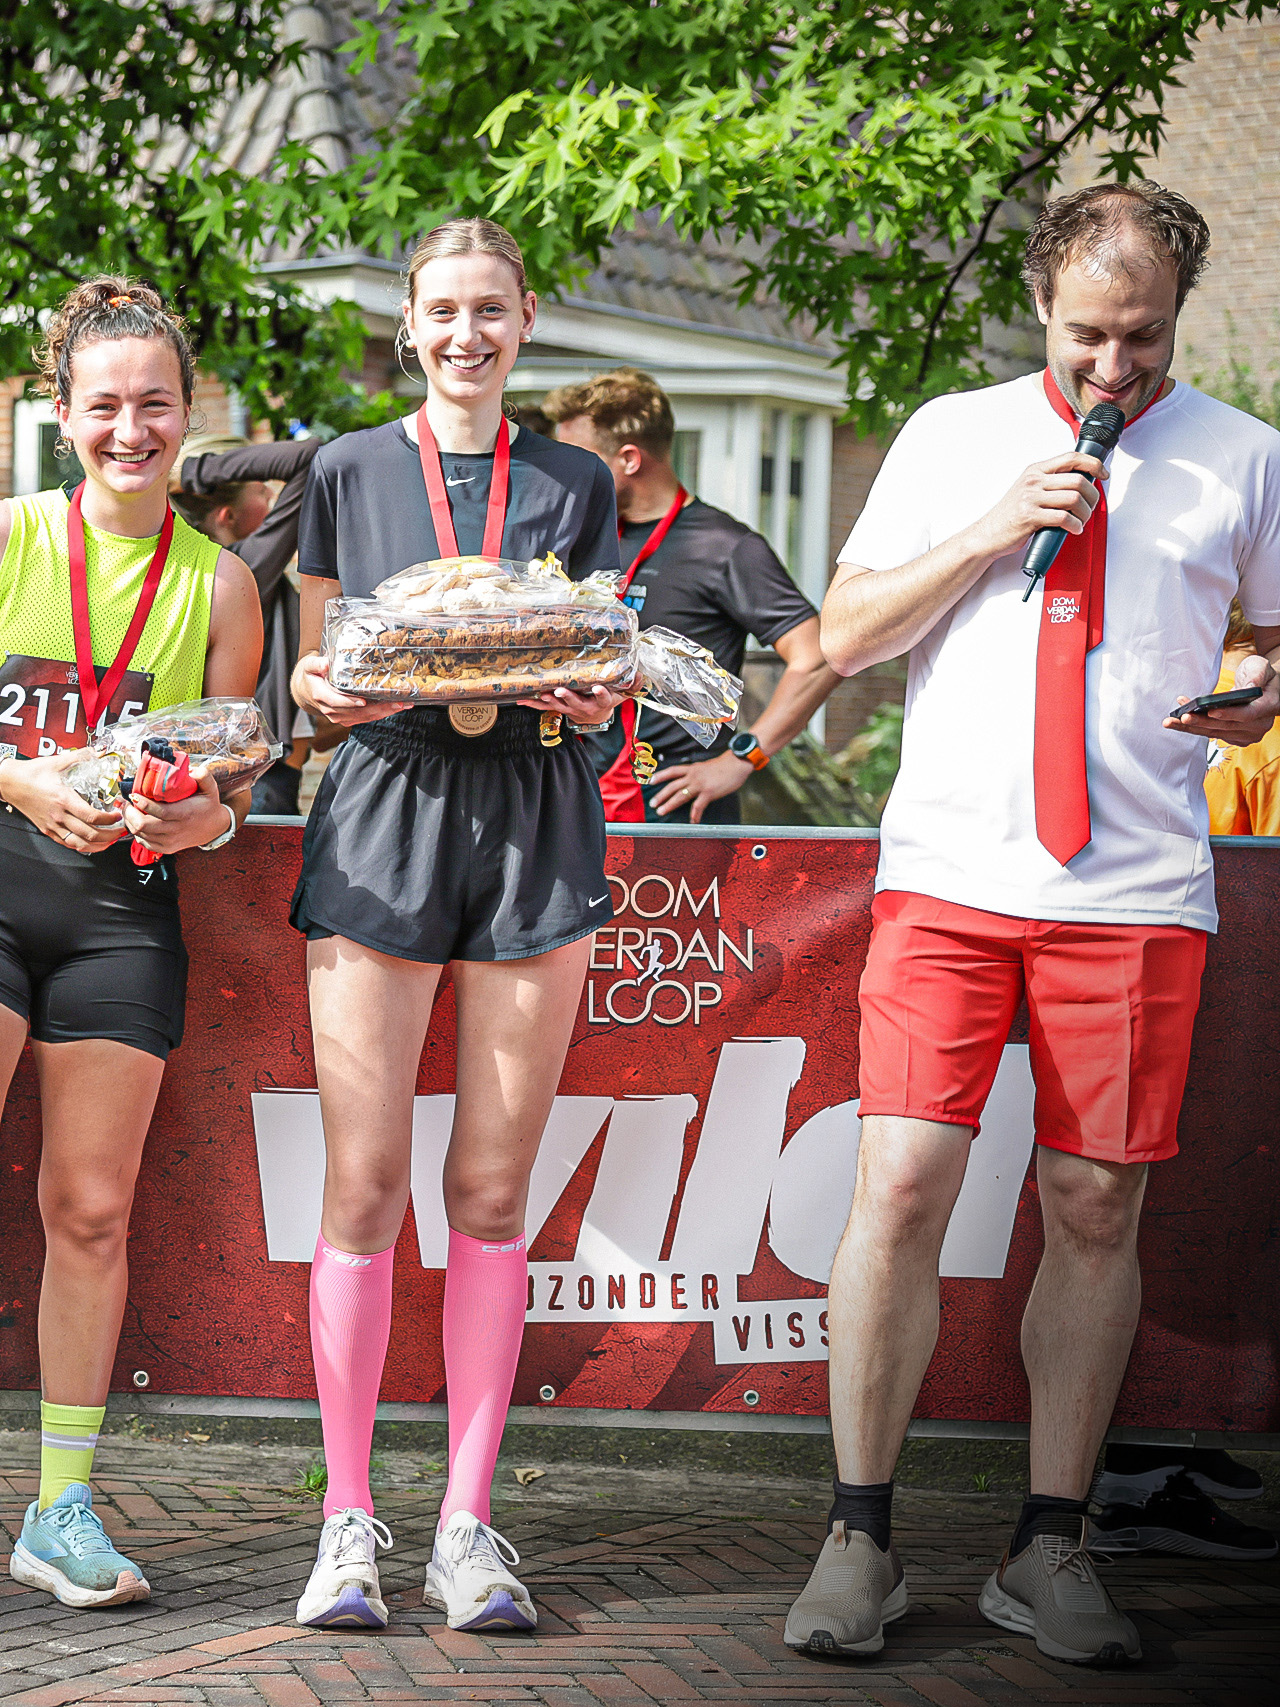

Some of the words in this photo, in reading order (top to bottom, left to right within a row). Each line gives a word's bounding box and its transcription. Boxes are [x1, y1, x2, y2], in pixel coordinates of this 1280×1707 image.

[1053, 597, 1075, 606] DOM
[1046, 605, 1080, 614] VERDAN
[1051, 614, 1075, 623] LOOP
[456, 706, 489, 714] VERDAN
[461, 714, 484, 723] LOOP
[588, 927, 754, 972] ERDAN
[588, 979, 723, 1025] LOOP
